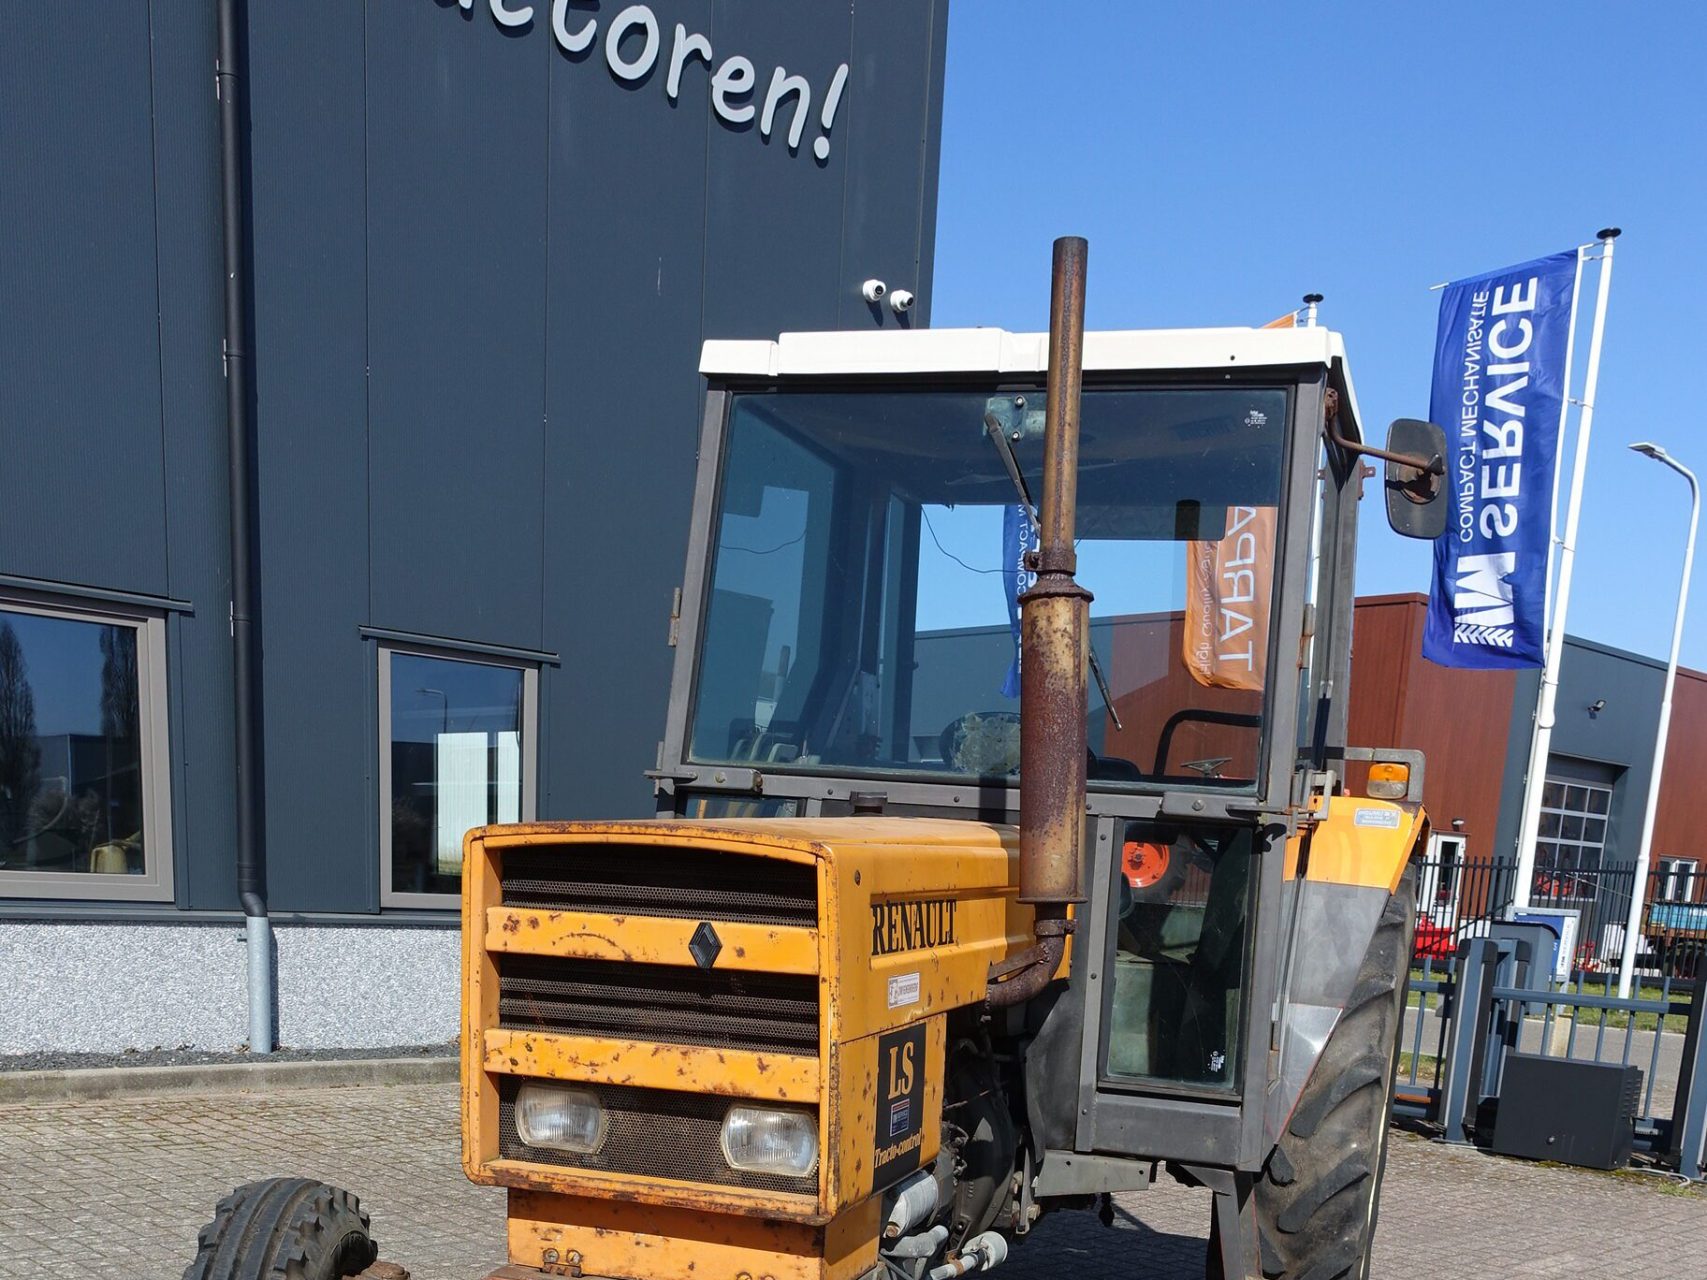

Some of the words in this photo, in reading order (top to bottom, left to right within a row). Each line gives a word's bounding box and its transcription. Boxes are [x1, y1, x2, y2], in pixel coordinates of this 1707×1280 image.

[871, 899, 957, 956] RENAULT
[888, 1041, 915, 1100] LS
[875, 1127, 922, 1168] Tracto-control
